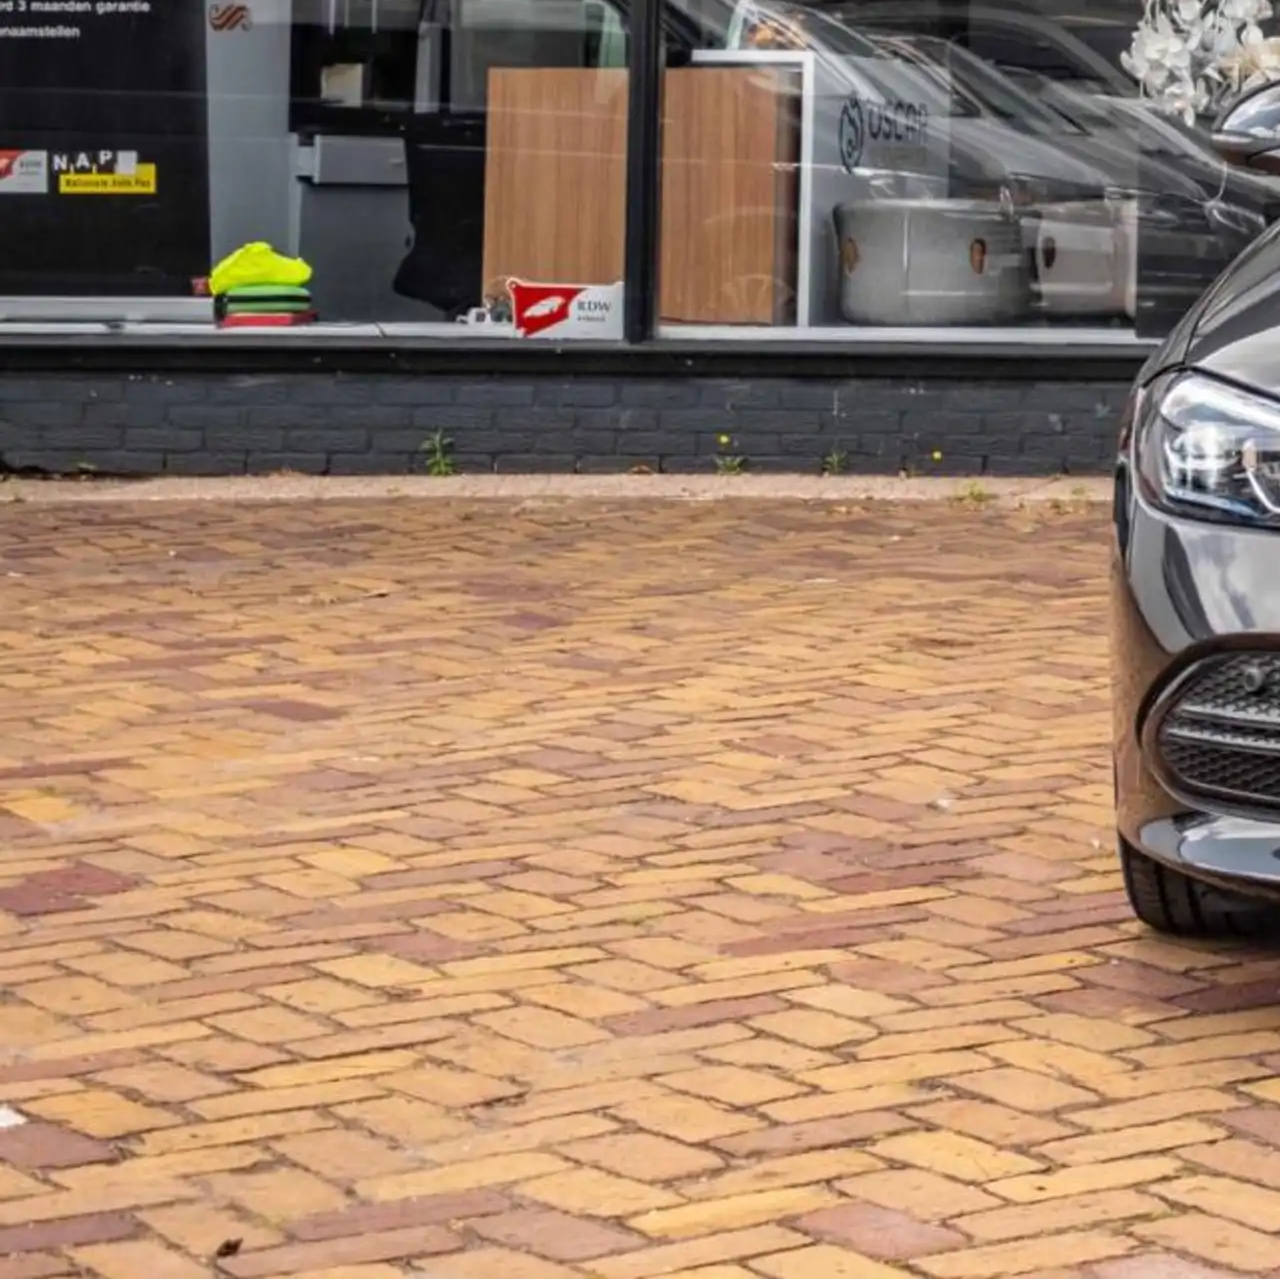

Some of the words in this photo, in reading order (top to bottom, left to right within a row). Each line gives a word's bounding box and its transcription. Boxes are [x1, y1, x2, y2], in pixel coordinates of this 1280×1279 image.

[18, 0, 27, 12] 3
[30, 0, 92, 12] maanden
[96, 0, 151, 15] garantie
